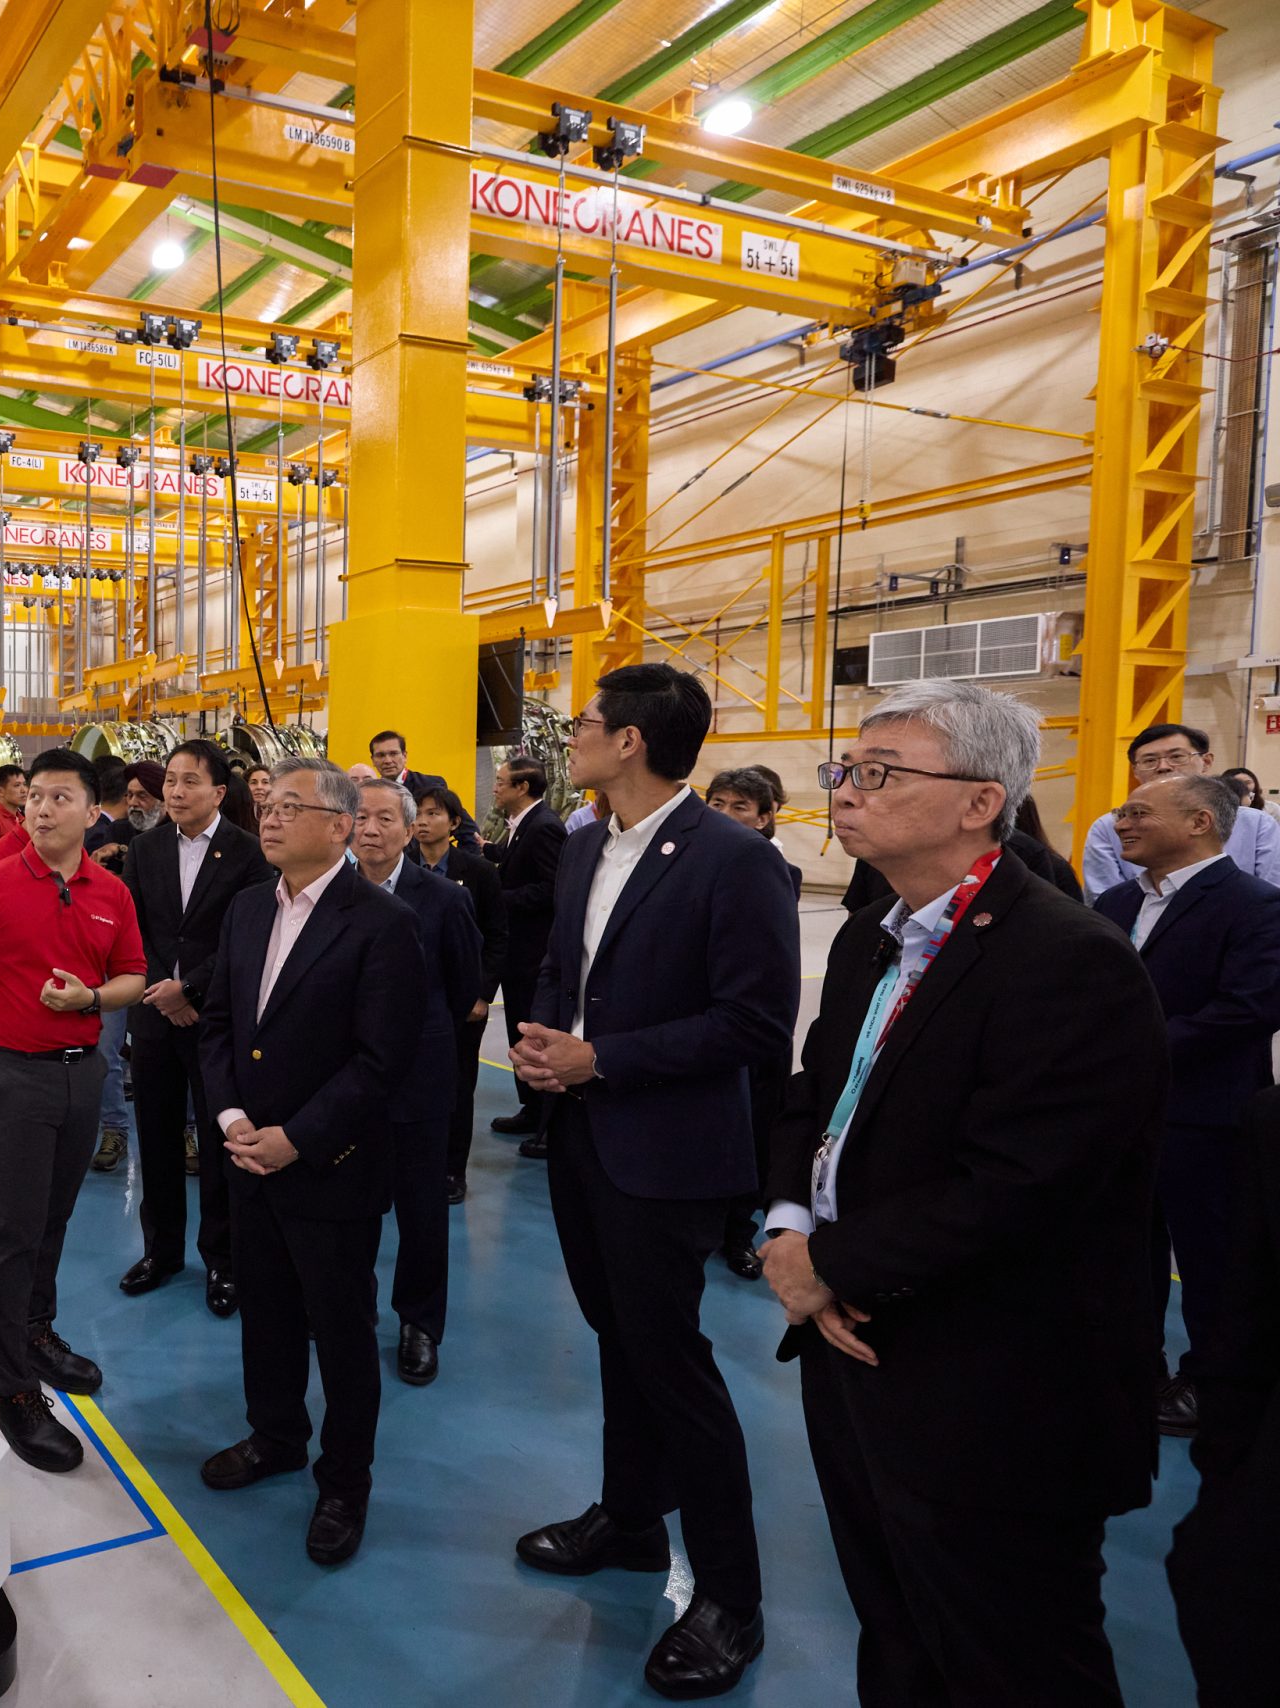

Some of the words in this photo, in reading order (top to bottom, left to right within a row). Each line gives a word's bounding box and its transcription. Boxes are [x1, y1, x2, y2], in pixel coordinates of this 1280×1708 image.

[289, 127, 302, 140] LM
[305, 130, 342, 150] 1136590
[344, 141, 350, 152] B
[836, 177, 852, 191] SWL
[472, 173, 714, 259] KONECRANES
[763, 239, 778, 252] SWL
[746, 248, 760, 270] 5t
[765, 256, 776, 272] +
[780, 254, 795, 277] 5t
[68, 339, 80, 349] LM
[139, 350, 177, 369] FC-5(L)
[11, 456, 42, 469] FC-4(L)
[64, 464, 218, 497] KONECRANES
[240, 486, 251, 500] 5t
[252, 491, 261, 500] +
[263, 488, 273, 502] 5t
